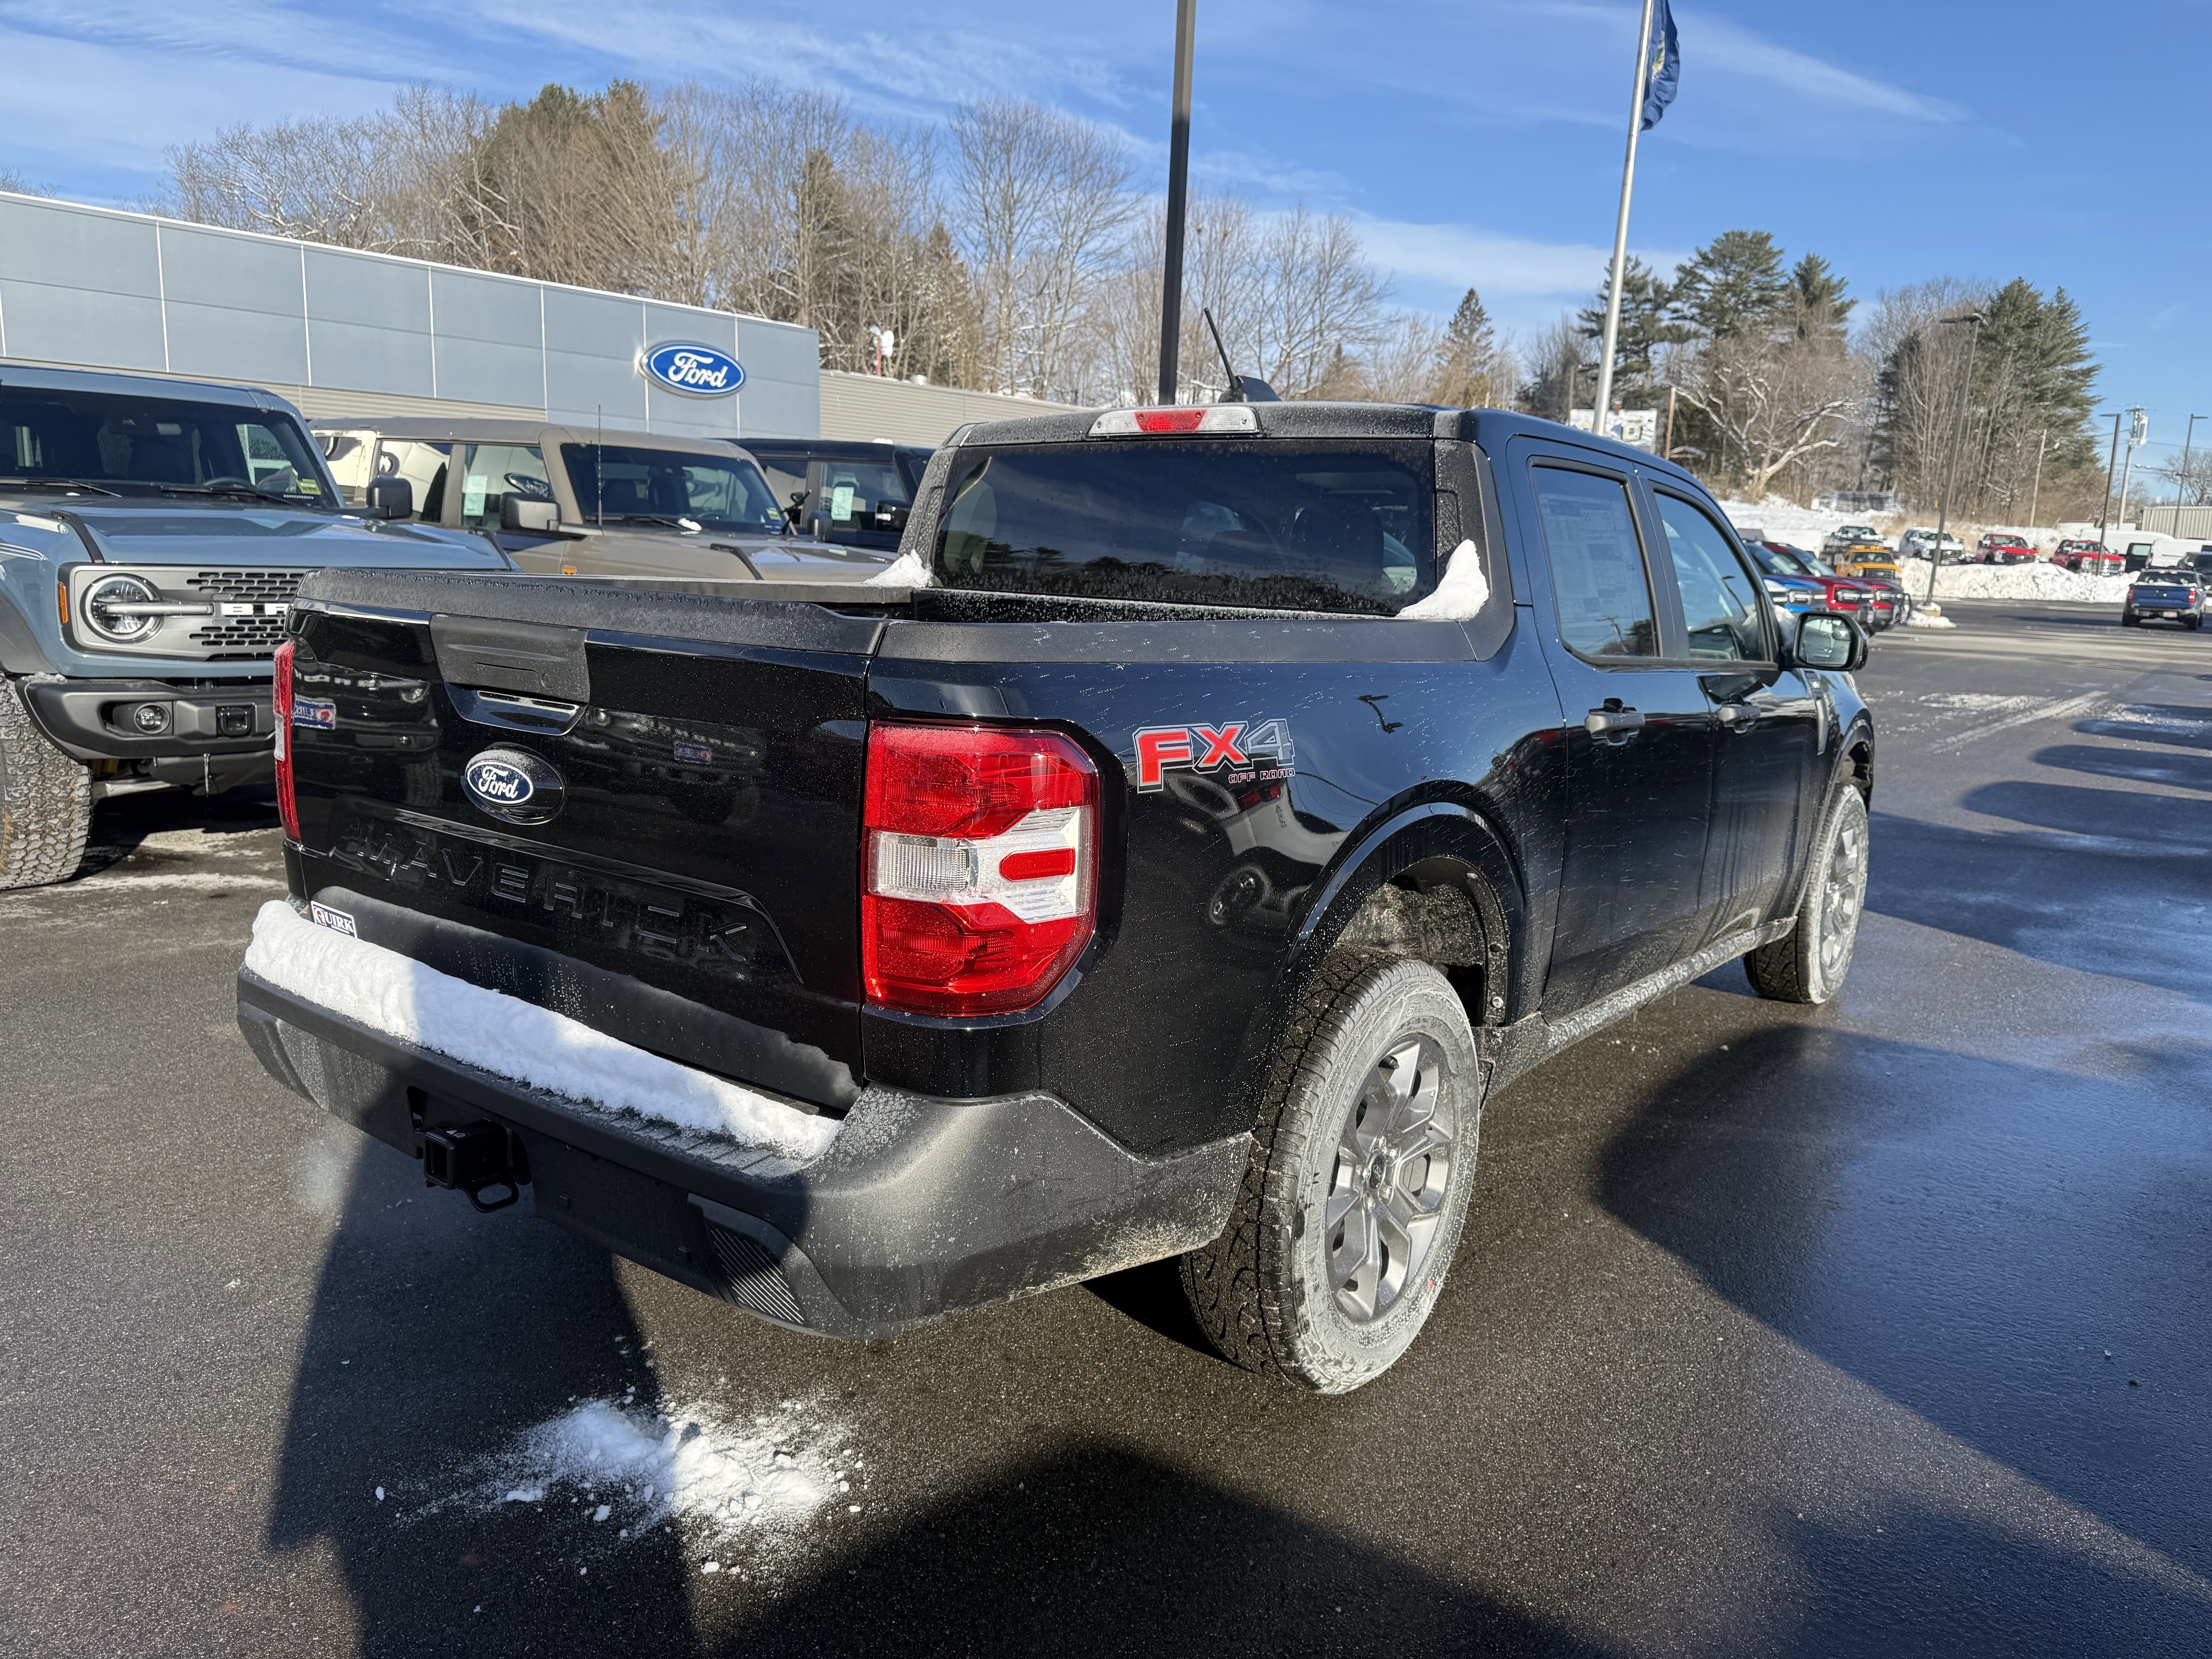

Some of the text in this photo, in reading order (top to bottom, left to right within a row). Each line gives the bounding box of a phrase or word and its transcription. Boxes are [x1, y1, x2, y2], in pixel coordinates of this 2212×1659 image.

[668, 352, 728, 387] Ford
[1133, 718, 1295, 793] FX4
[479, 766, 519, 799] Ford
[1228, 768, 1295, 783] OFF ROAD
[356, 833, 747, 962] MAVERICK
[313, 905, 354, 933] QUIRK
